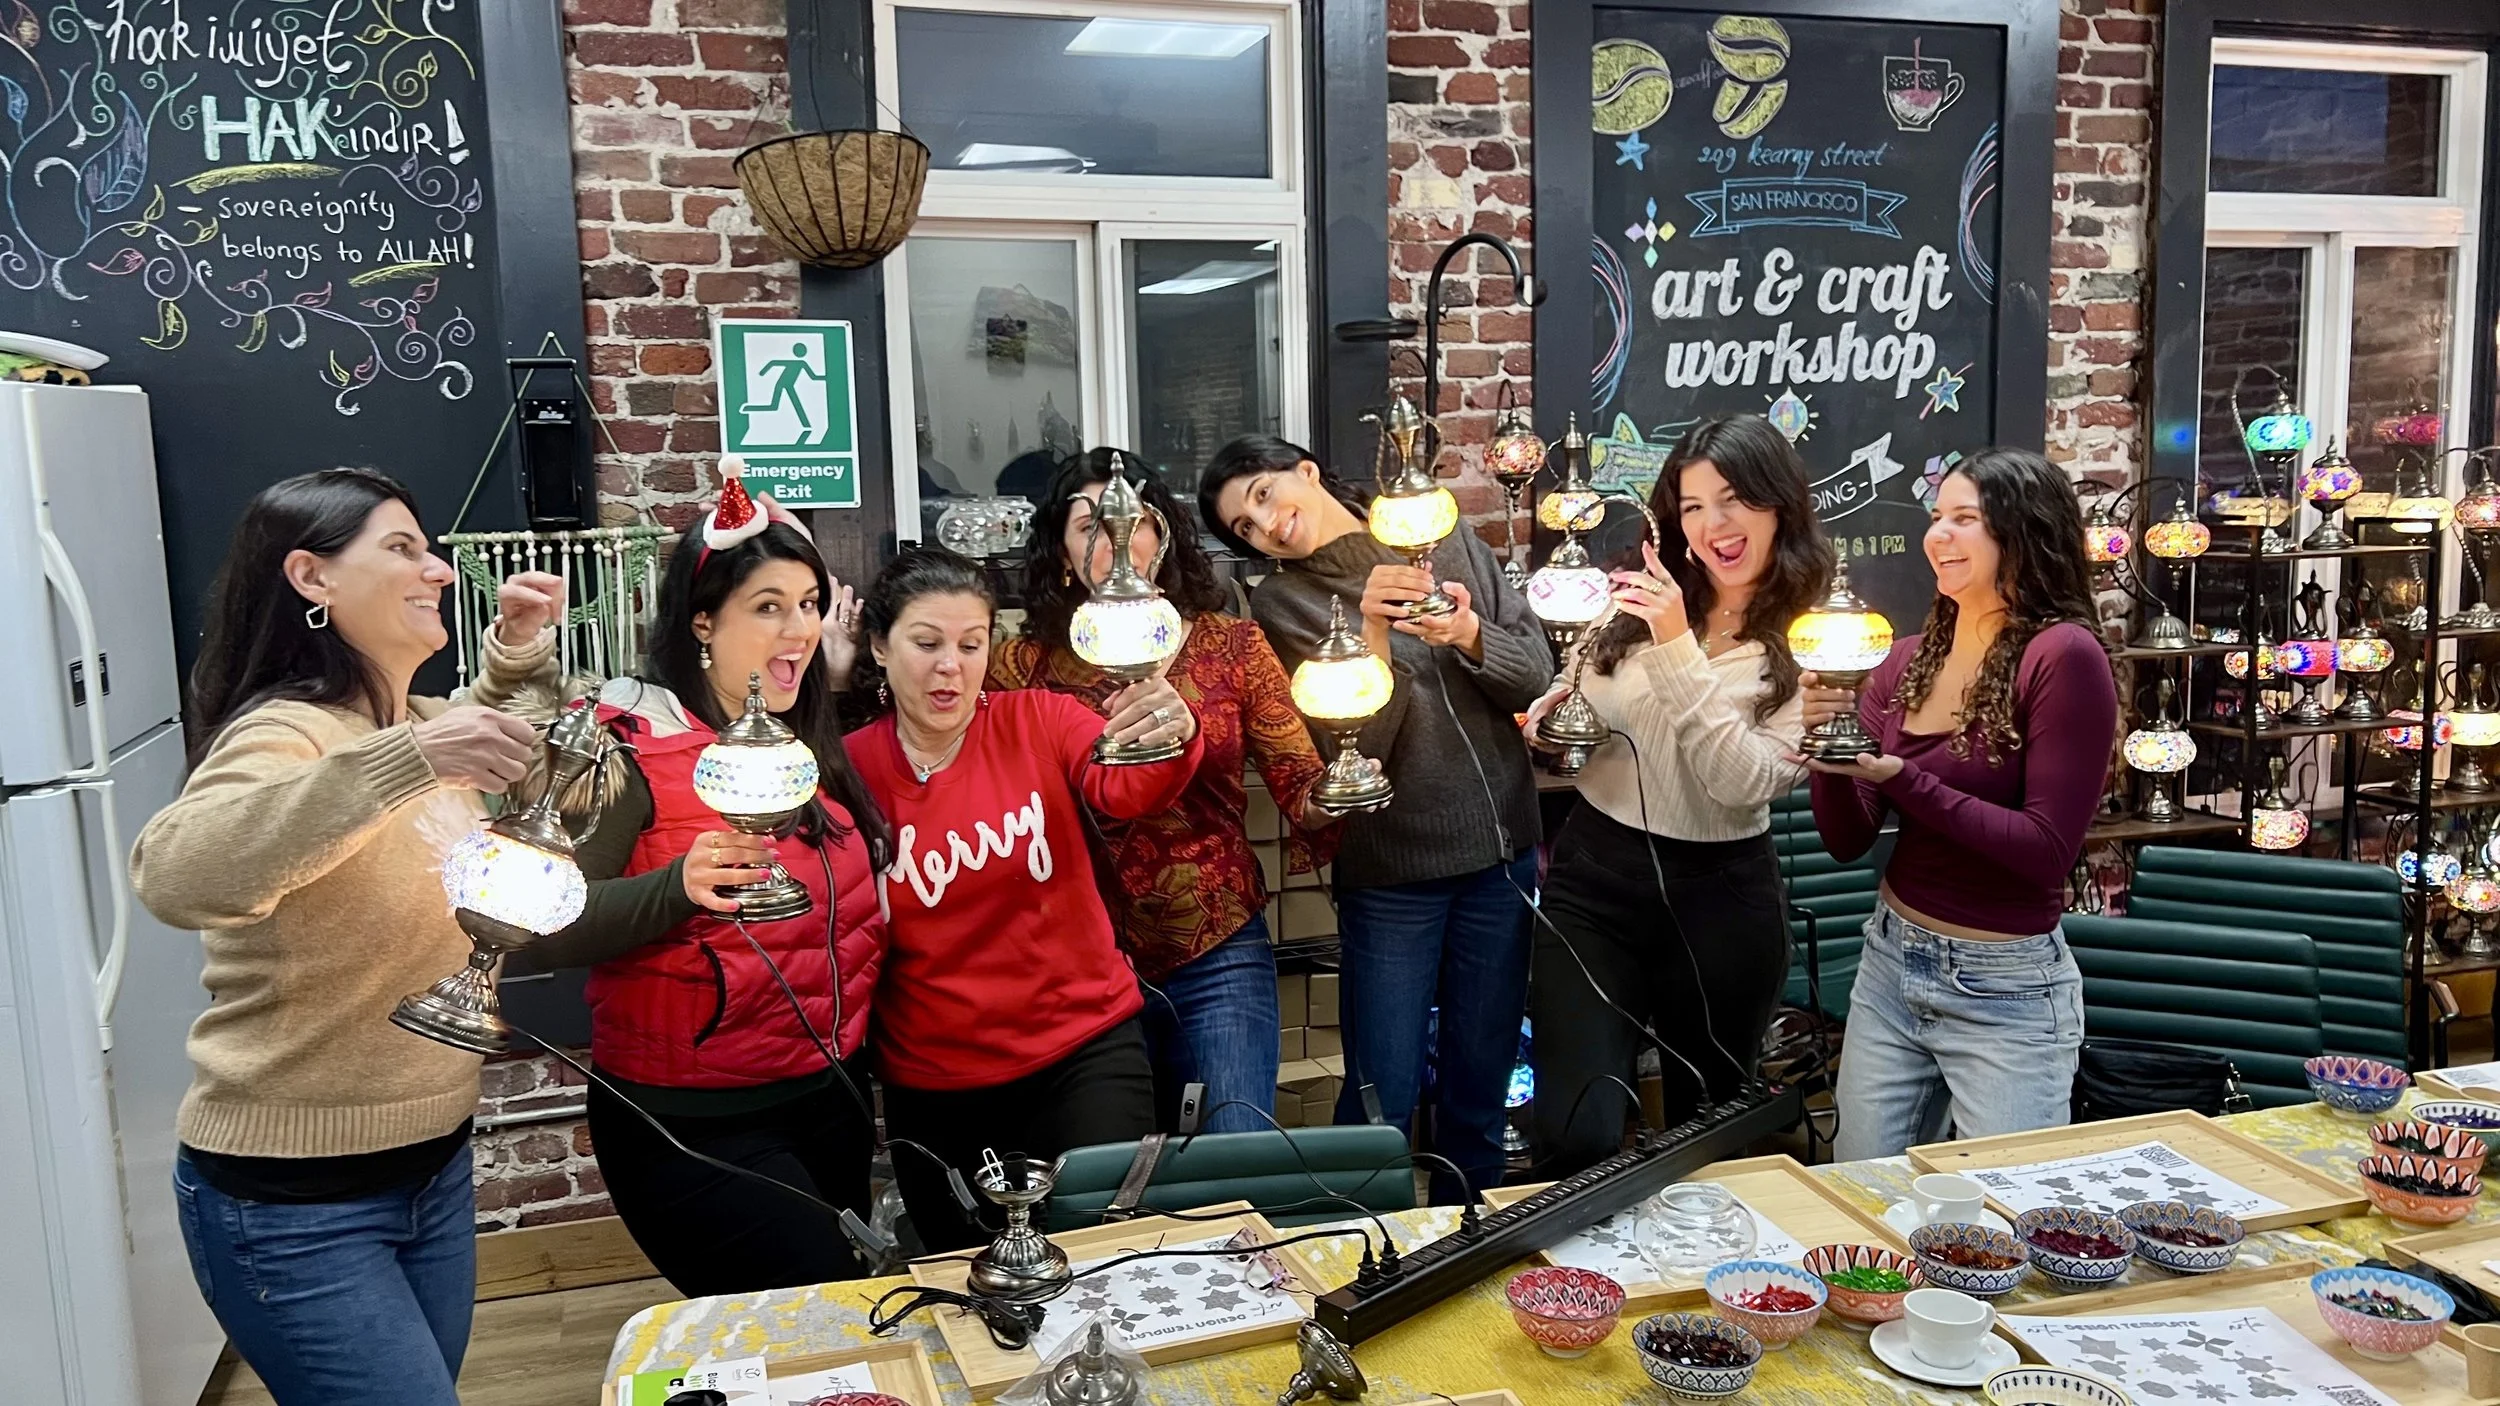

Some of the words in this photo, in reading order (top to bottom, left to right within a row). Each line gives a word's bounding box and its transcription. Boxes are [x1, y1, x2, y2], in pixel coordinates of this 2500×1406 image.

[1730, 191, 1763, 212] SAN
[1765, 190, 1859, 213] FRANCISCO
[221, 233, 323, 280] belongs
[336, 240, 363, 263] to
[375, 232, 476, 269] ALLAH!
[1651, 257, 1744, 319] art
[1753, 247, 1803, 317] &
[1817, 244, 1954, 332] craft
[1665, 321, 1937, 400] workshop
[742, 463, 845, 481] Emergency
[773, 484, 812, 499] Exit
[1881, 534, 1906, 556] PM
[1195, 1313, 1247, 1328] DESIGN
[2120, 1320, 2201, 1330] TEMPLATE
